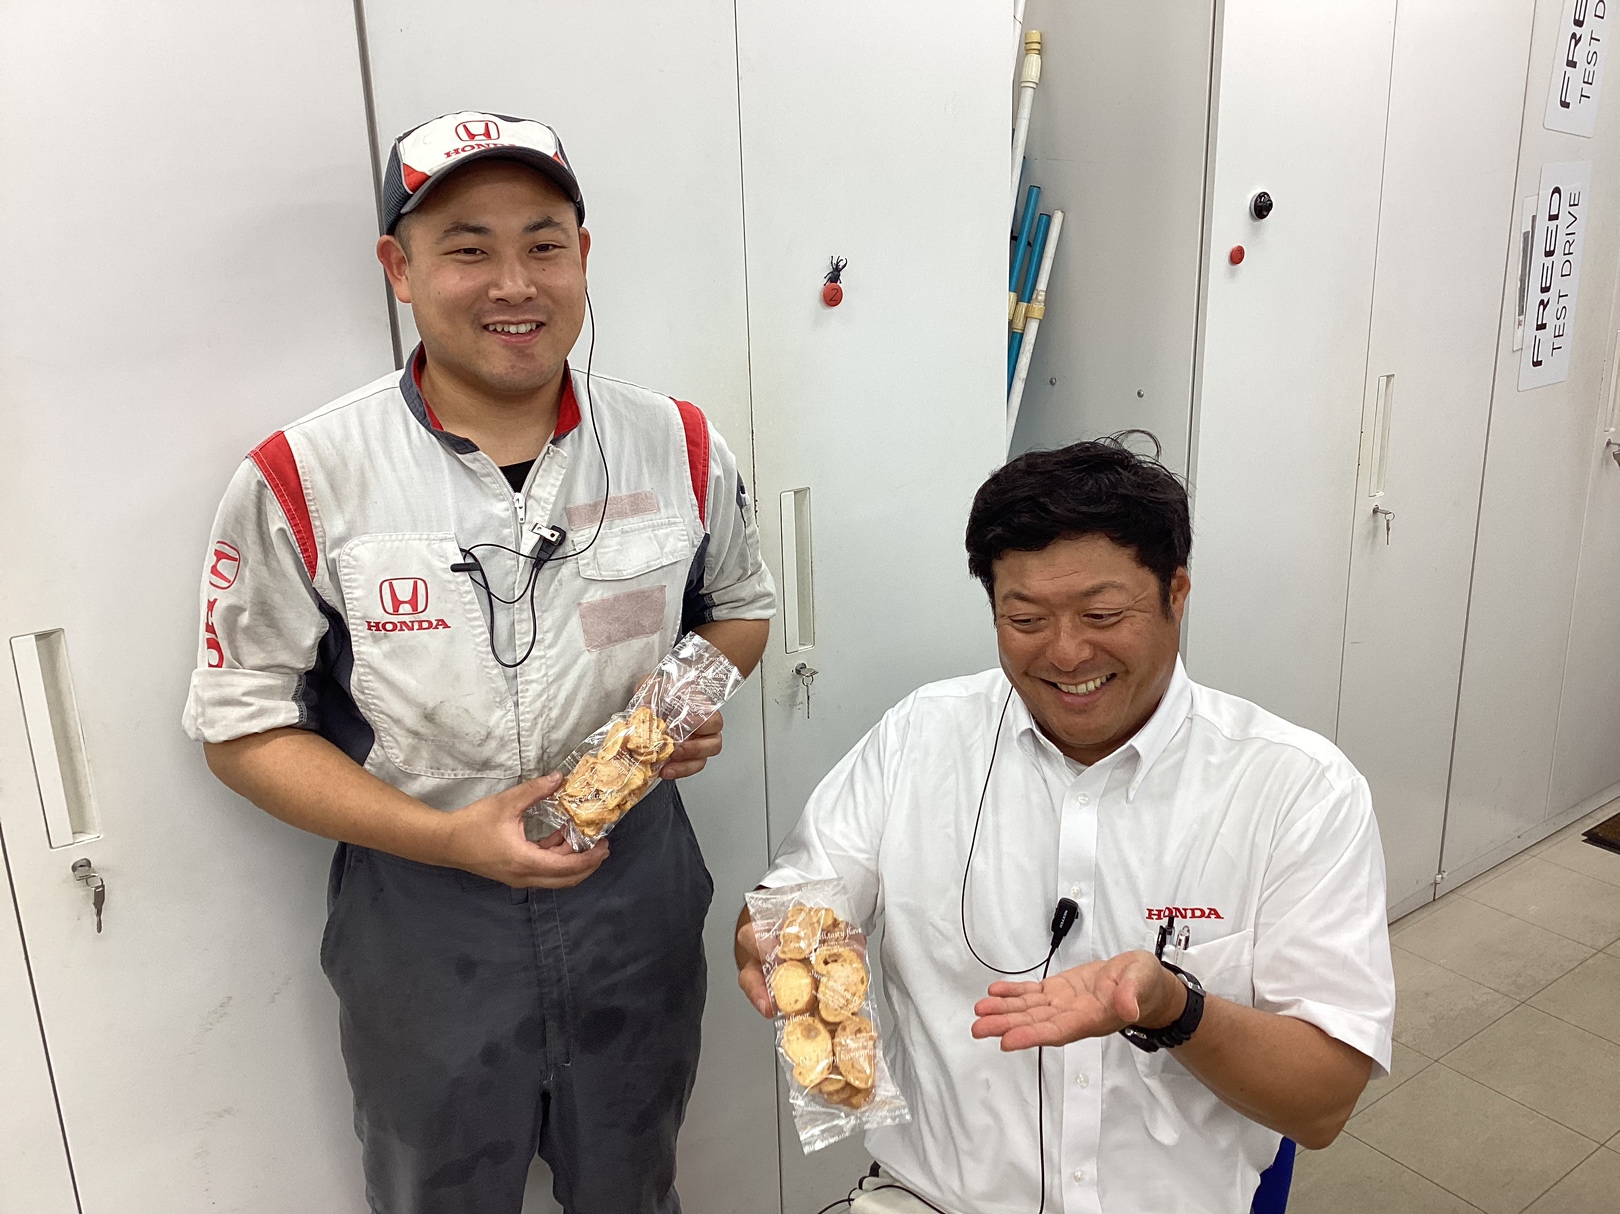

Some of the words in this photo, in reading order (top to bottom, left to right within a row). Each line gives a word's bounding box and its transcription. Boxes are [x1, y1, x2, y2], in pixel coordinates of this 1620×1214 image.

[1579, 29, 1601, 104] TEST
[444, 143, 516, 158] HON
[1532, 186, 1562, 367] FREED
[1551, 289, 1569, 357] TEST
[1560, 190, 1581, 278] DRIVE
[829, 288, 839, 302] 2
[364, 618, 452, 633] HONDA
[1145, 906, 1225, 921] HONDA
